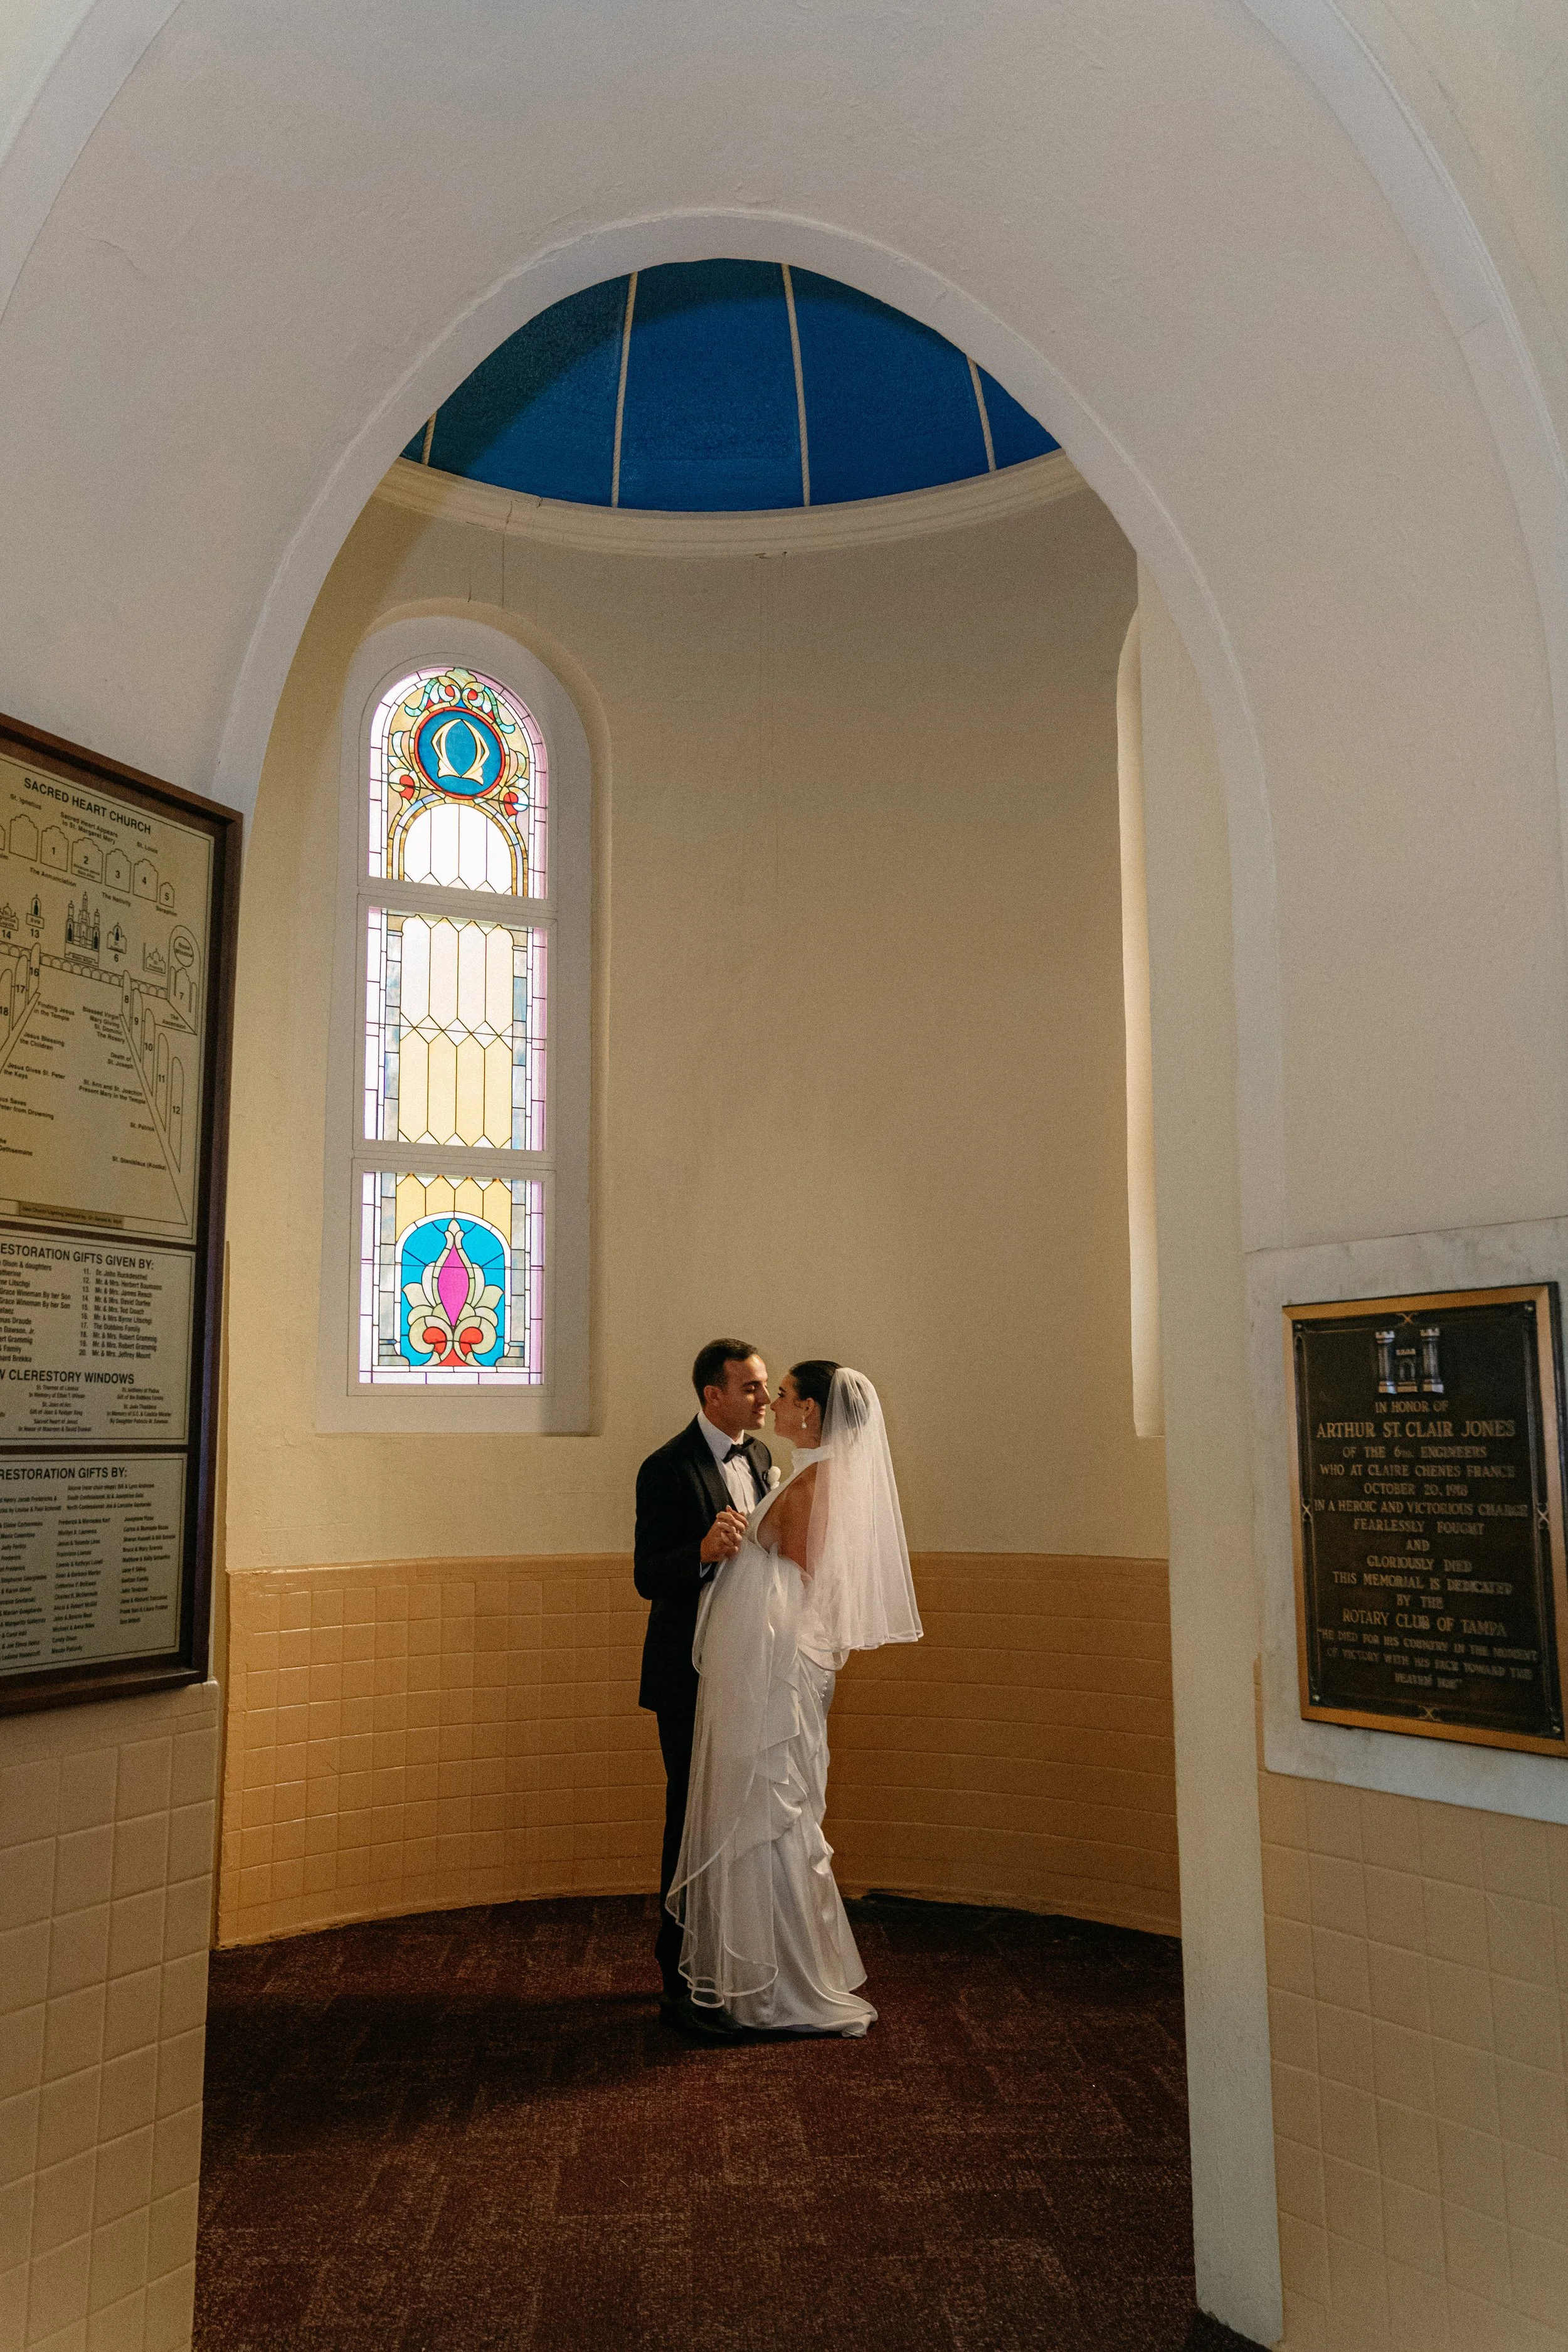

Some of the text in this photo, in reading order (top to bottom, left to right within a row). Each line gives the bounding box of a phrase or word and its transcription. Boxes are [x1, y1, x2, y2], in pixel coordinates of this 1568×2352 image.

[24, 778, 151, 835] SACRED HEART CHURCH
[61, 812, 80, 824] Sacred
[96, 825, 118, 838] Appears
[78, 825, 102, 839] Margaret
[103, 834, 115, 845] Mary
[52, 847, 56, 855] 1
[83, 856, 88, 865] 2
[30, 867, 40, 876] The
[115, 870, 120, 879] 3
[142, 876, 147, 885] 4
[102, 892, 111, 900] The
[164, 893, 169, 901] 5
[2, 930, 11, 940] 14
[31, 928, 40, 938] 13
[114, 954, 119, 963] 6
[30, 967, 40, 977] 16
[16, 984, 26, 993] 17
[124, 995, 129, 1004] 8
[0, 1006, 8, 1016] 18
[51, 1012, 70, 1021] Temple
[60, 1007, 75, 1015] Jesus
[82, 1006, 103, 1016] Blessed
[90, 1015, 120, 1029] Mary Giving
[134, 1017, 139, 1025] 9
[24, 1032, 65, 1047] Jesus Blessing
[107, 1034, 125, 1044] Rosary
[30, 1040, 53, 1051] Children
[144, 1042, 153, 1051] 10
[8, 1062, 24, 1071] Jesus
[26, 1066, 41, 1074] Gives
[51, 1071, 65, 1079] Peter
[14, 1071, 28, 1079] Keys
[158, 1074, 165, 1083] 11
[79, 1085, 99, 1094] Present
[100, 1090, 112, 1098] Mary
[129, 1096, 146, 1104] Temple
[28, 1109, 54, 1120] Drowning
[172, 1106, 181, 1115] 12
[1, 1243, 154, 1270] ESTORATION GIFTS GIVEN BY:
[9, 1369, 82, 1383] CLERESTORY
[84, 1372, 135, 1384] WINDOWS
[1375, 1400, 1449, 1413] IN HONOR OF
[1316, 1421, 1376, 1438] ARTHUR
[1405, 1421, 1453, 1438] CLAIR
[1461, 1419, 1515, 1437] JONES
[1343, 1446, 1357, 1458] OF
[1364, 1446, 1385, 1458] THE
[1421, 1446, 1487, 1458] ENGINEERS
[0, 1467, 127, 1480] RESTORATION GIFTS BY:
[1320, 1464, 1345, 1476] WHO
[1350, 1464, 1363, 1476] AT
[1367, 1464, 1409, 1476] CLAIRE
[1364, 1483, 1416, 1496] OCTOBER
[1314, 1499, 1325, 1512] IN
[1327, 1500, 1335, 1512] A
[1338, 1500, 1377, 1513] HEROIC
[1380, 1500, 1404, 1513] AND
[1406, 1501, 1473, 1515] VICTORIOUS
[1353, 1518, 1485, 1535] FEARLESSLY FOUGHT
[1406, 1539, 1430, 1552] AND
[1366, 1555, 1434, 1571] GLORIOUSLY
[1332, 1571, 1513, 1595] THIS MEMORIAL IS DEDICATED
[1396, 1594, 1444, 1610] BY THE
[1342, 1608, 1507, 1638] ROTARY CLUB OF TAMPA
